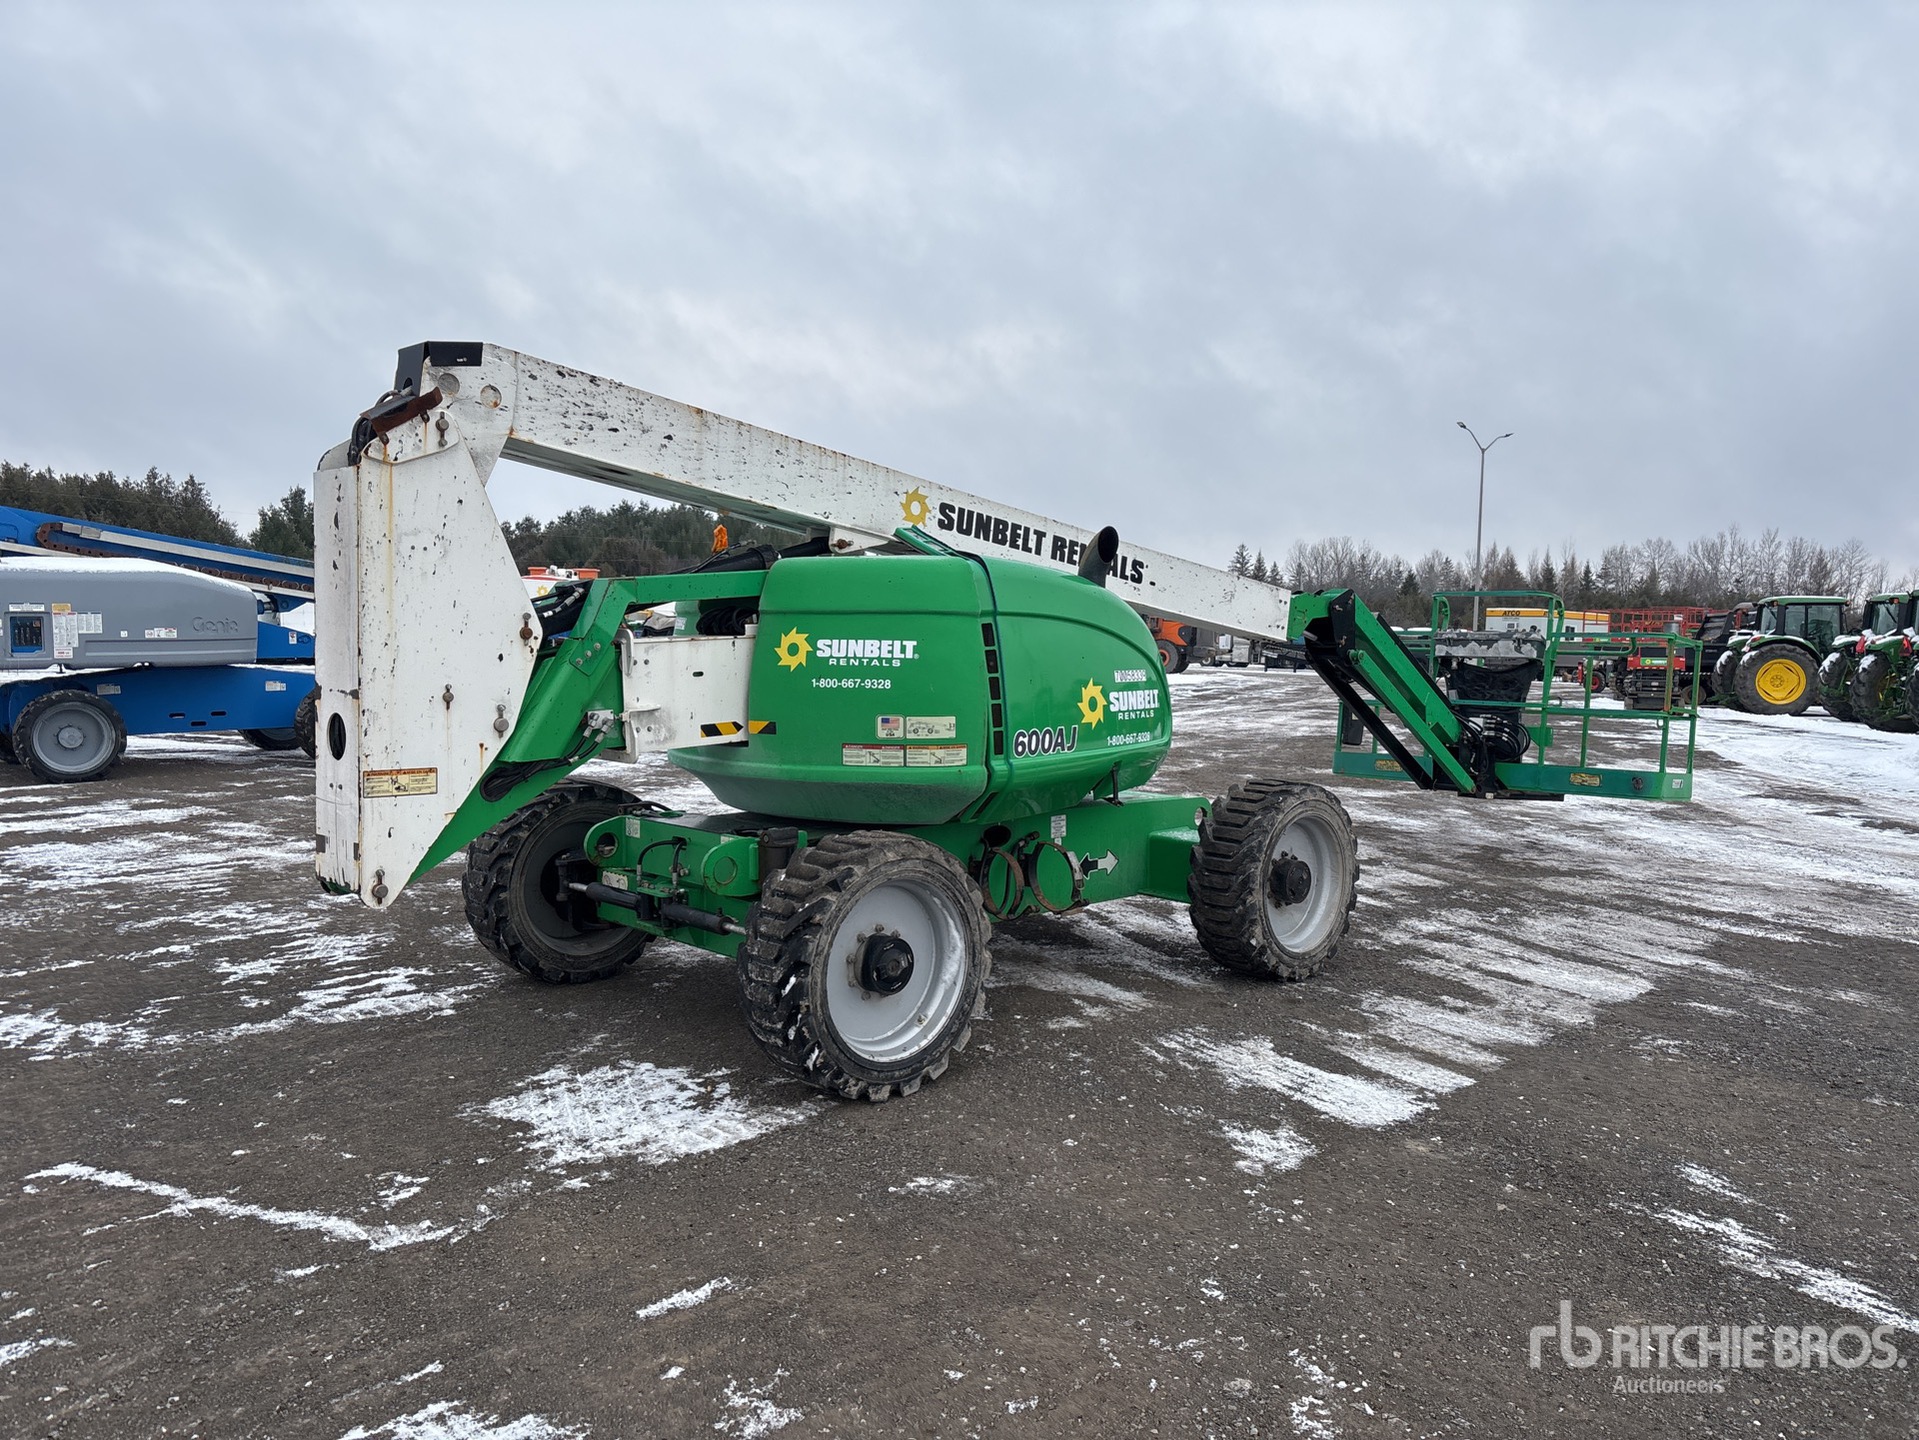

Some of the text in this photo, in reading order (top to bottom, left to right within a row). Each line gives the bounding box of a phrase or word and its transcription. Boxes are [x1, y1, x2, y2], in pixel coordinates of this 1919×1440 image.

[937, 502, 1144, 584] SUNBELT REALS
[193, 616, 238, 632] Genie
[816, 639, 917, 659] SUNBELT
[829, 659, 901, 667] RENTALS
[811, 678, 891, 689] 1-800-667-9328
[1109, 689, 1159, 712] SUNBELT
[1118, 709, 1154, 720] RENTALS
[1013, 725, 1078, 758] 600AJ
